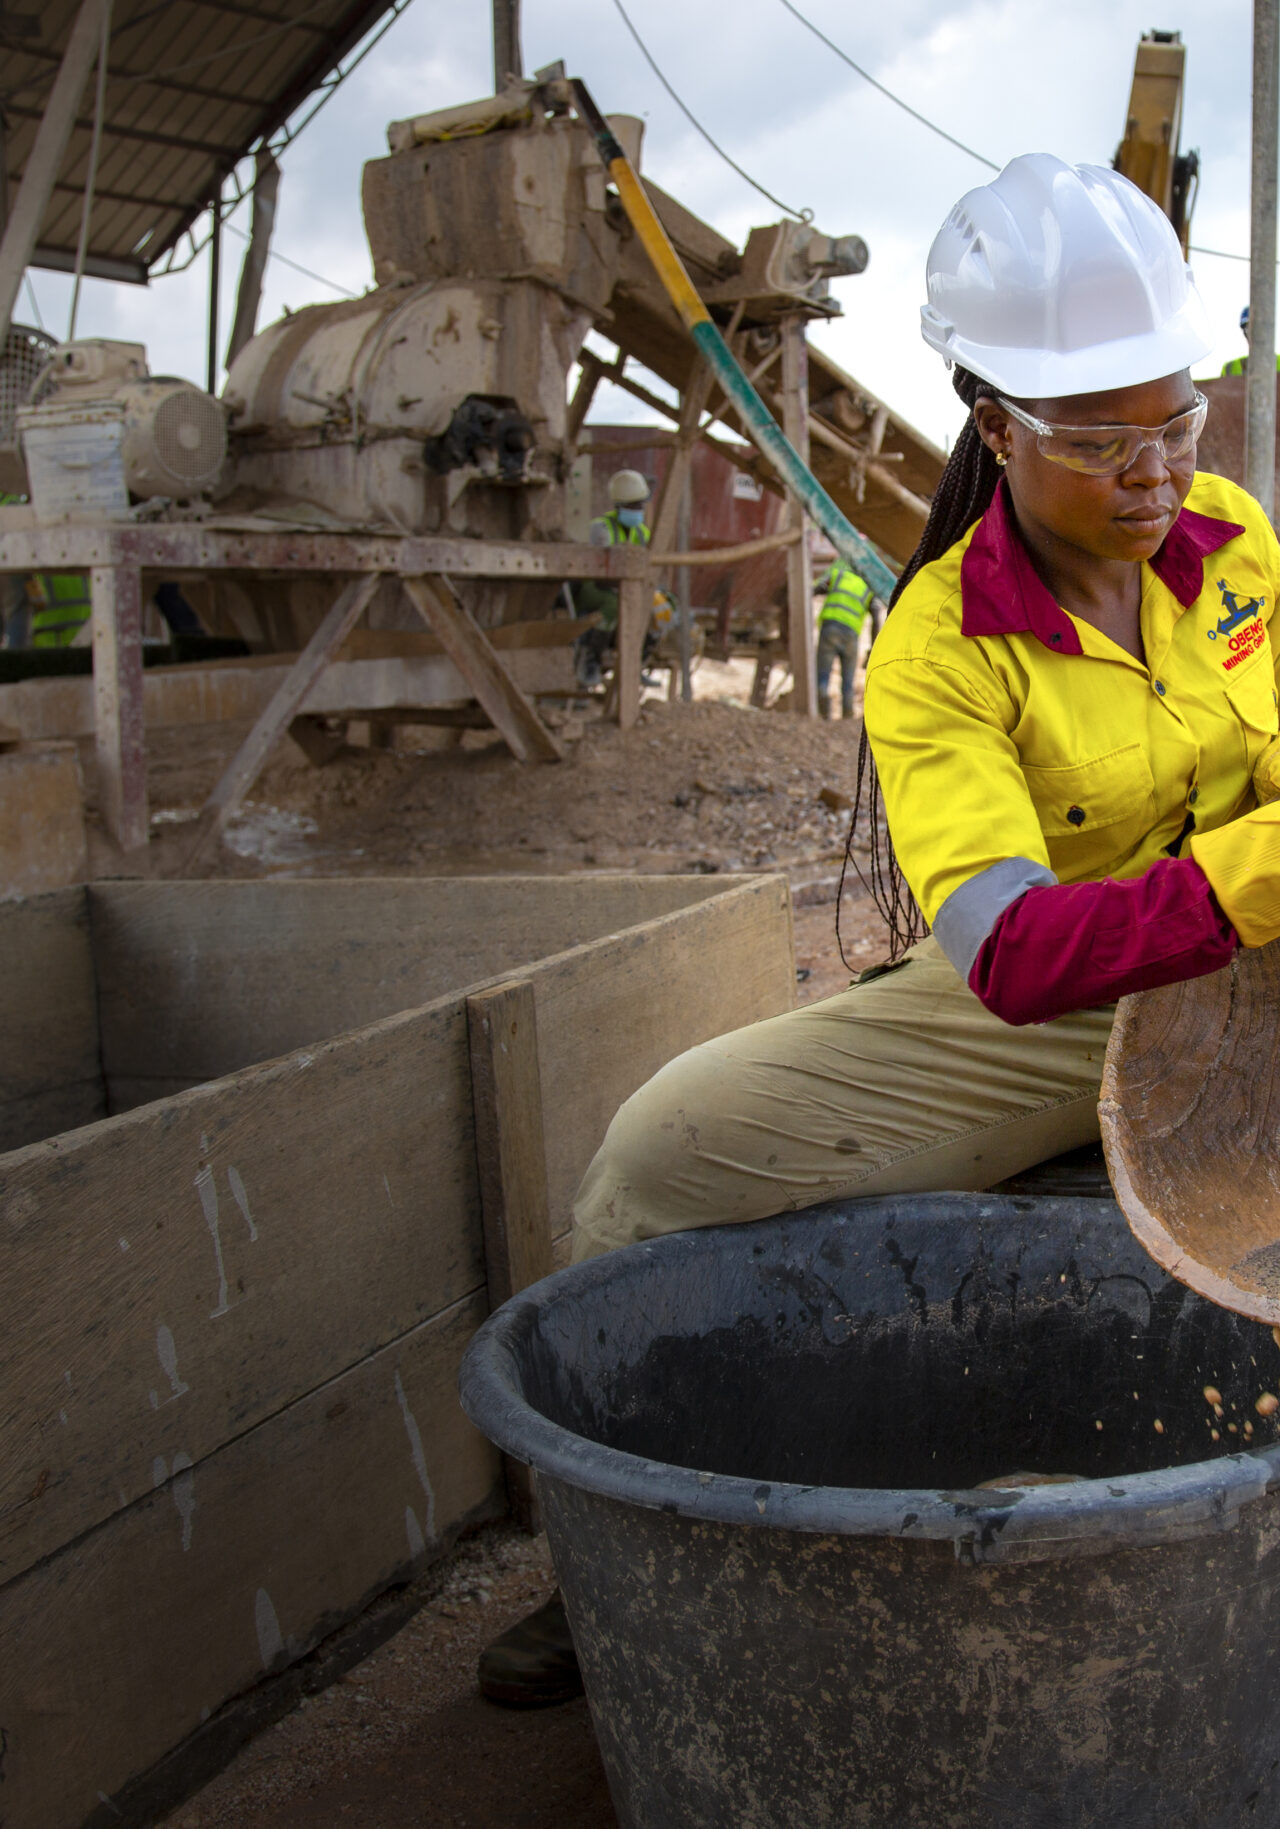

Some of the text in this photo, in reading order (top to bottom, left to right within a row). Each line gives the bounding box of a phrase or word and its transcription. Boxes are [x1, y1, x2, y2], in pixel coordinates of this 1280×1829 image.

[1207, 630, 1217, 640] O
[1228, 618, 1263, 651] OBENG
[1222, 644, 1254, 671] MINING
